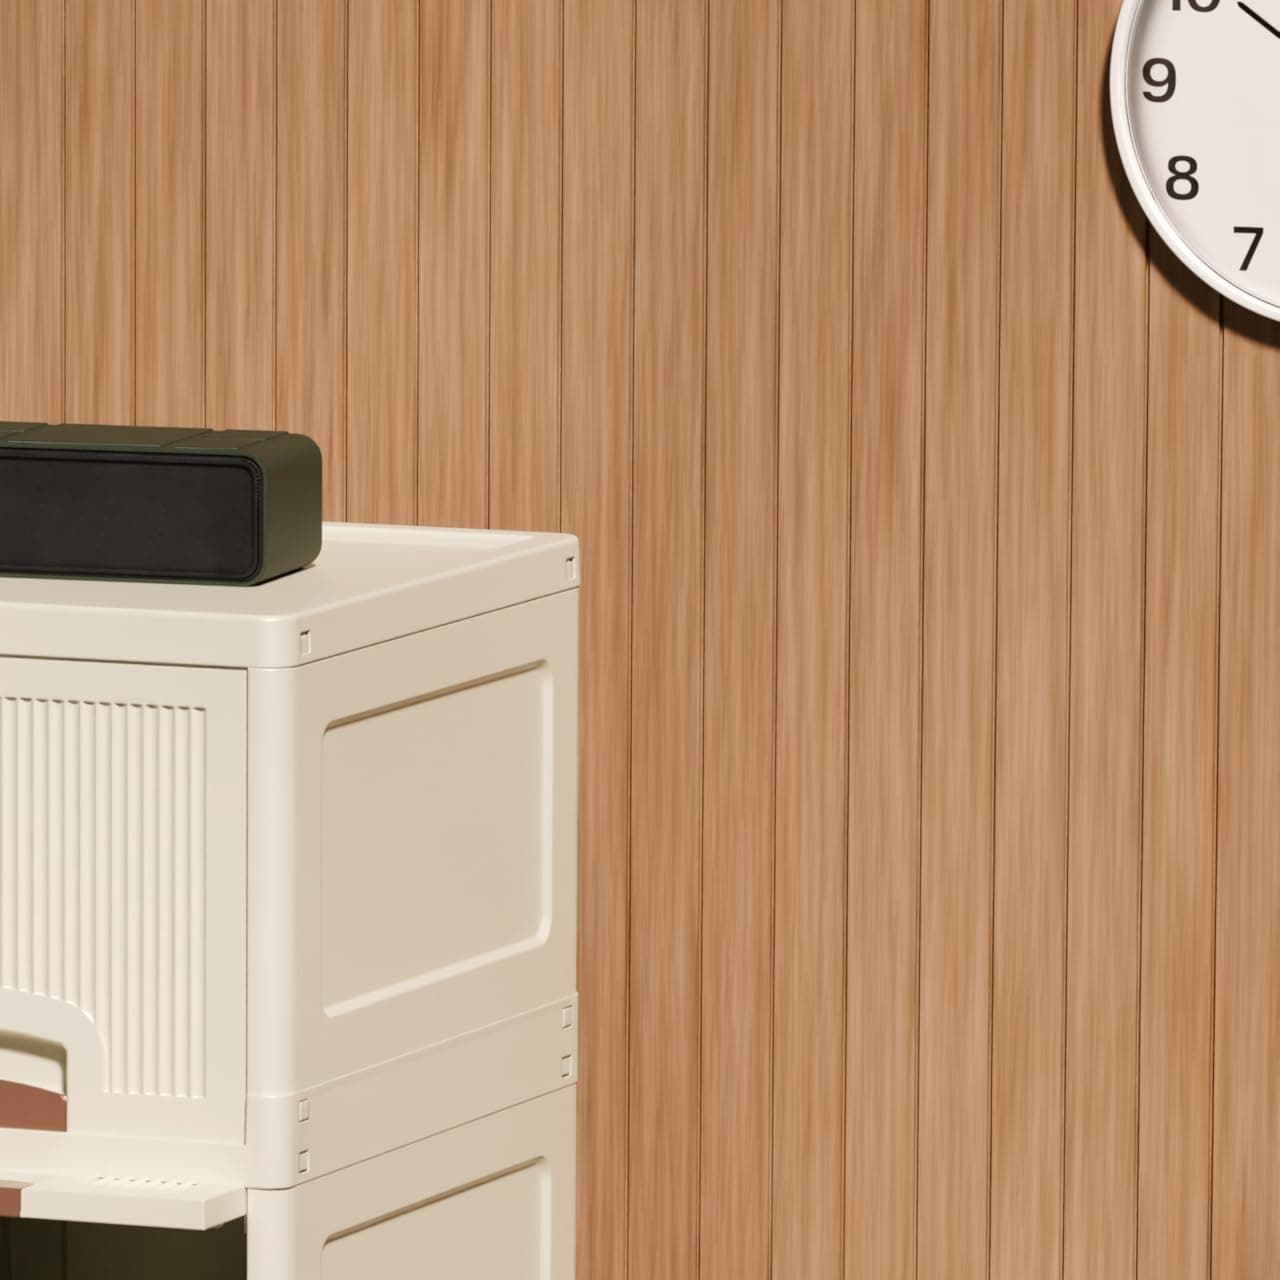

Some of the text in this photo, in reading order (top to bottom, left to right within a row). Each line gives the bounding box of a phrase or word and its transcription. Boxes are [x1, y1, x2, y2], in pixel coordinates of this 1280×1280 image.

[1142, 58, 1176, 103] 9
[1165, 156, 1199, 201] 8
[1233, 226, 1264, 271] 7
